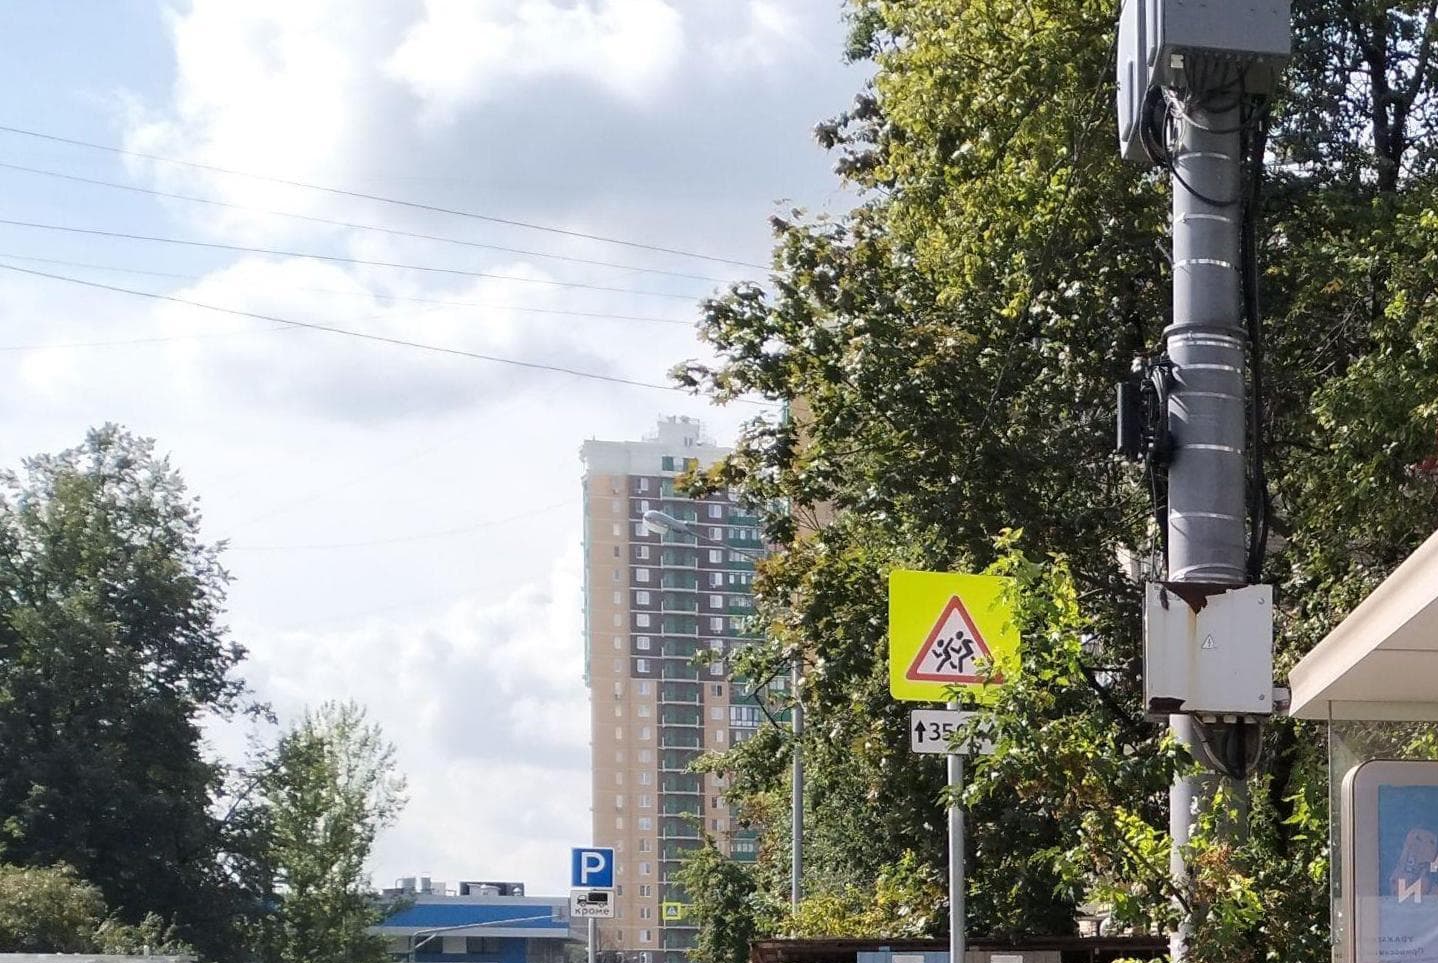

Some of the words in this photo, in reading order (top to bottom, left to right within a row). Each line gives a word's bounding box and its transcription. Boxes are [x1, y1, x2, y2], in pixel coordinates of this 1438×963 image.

[581, 852, 605, 884] P
[1397, 878, 1422, 904] И
[574, 907, 610, 916] кроме
